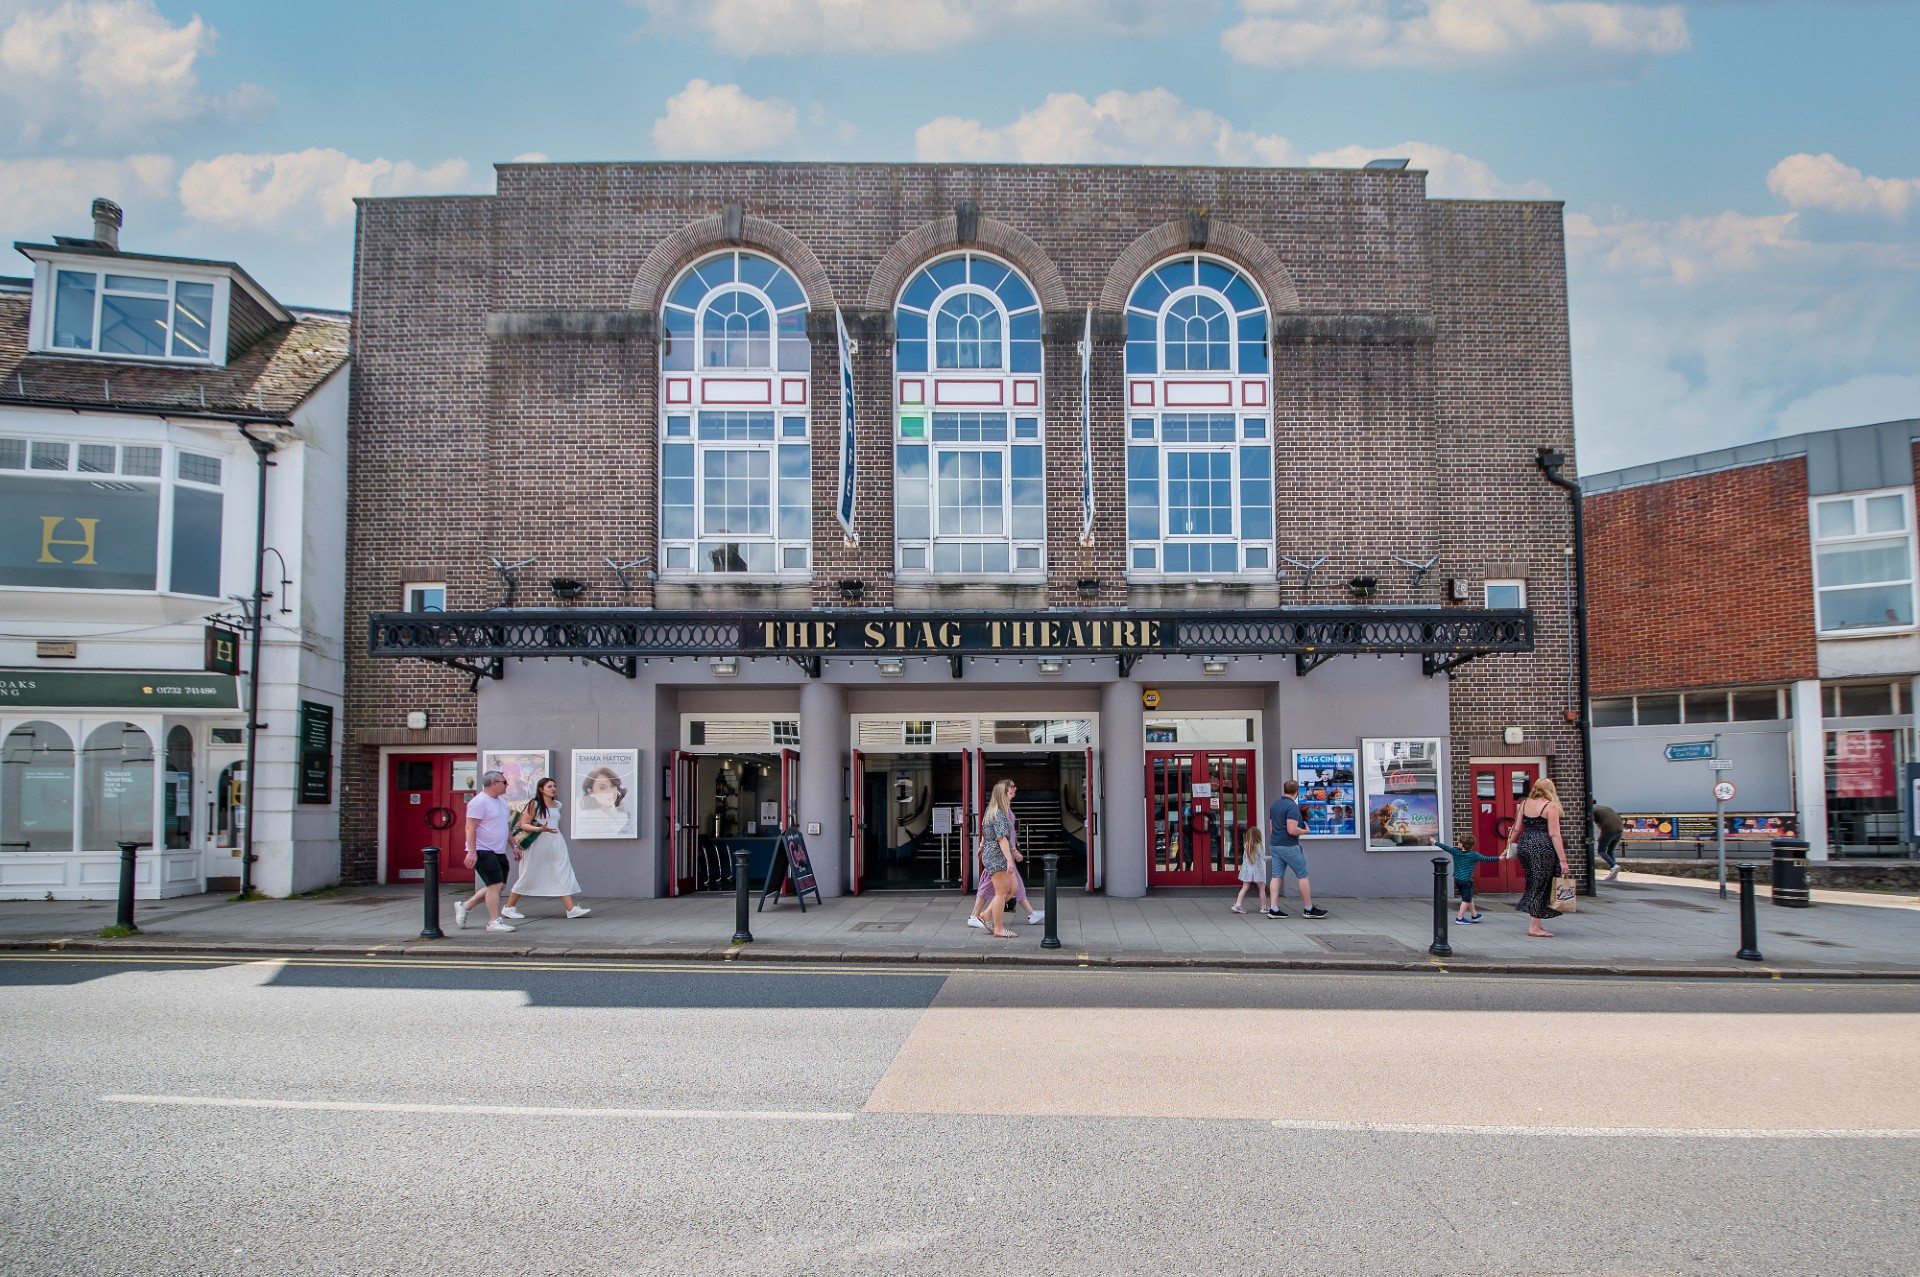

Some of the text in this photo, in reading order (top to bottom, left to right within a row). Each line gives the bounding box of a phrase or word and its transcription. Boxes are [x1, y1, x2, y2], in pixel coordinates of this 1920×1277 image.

[37, 516, 100, 565] H
[758, 620, 1161, 648] THE STAG THEATRE
[216, 639, 233, 663] H
[156, 686, 182, 694] 01732
[1300, 755, 1351, 763] STAG CINEMA
[1411, 812, 1435, 821] RAYA
